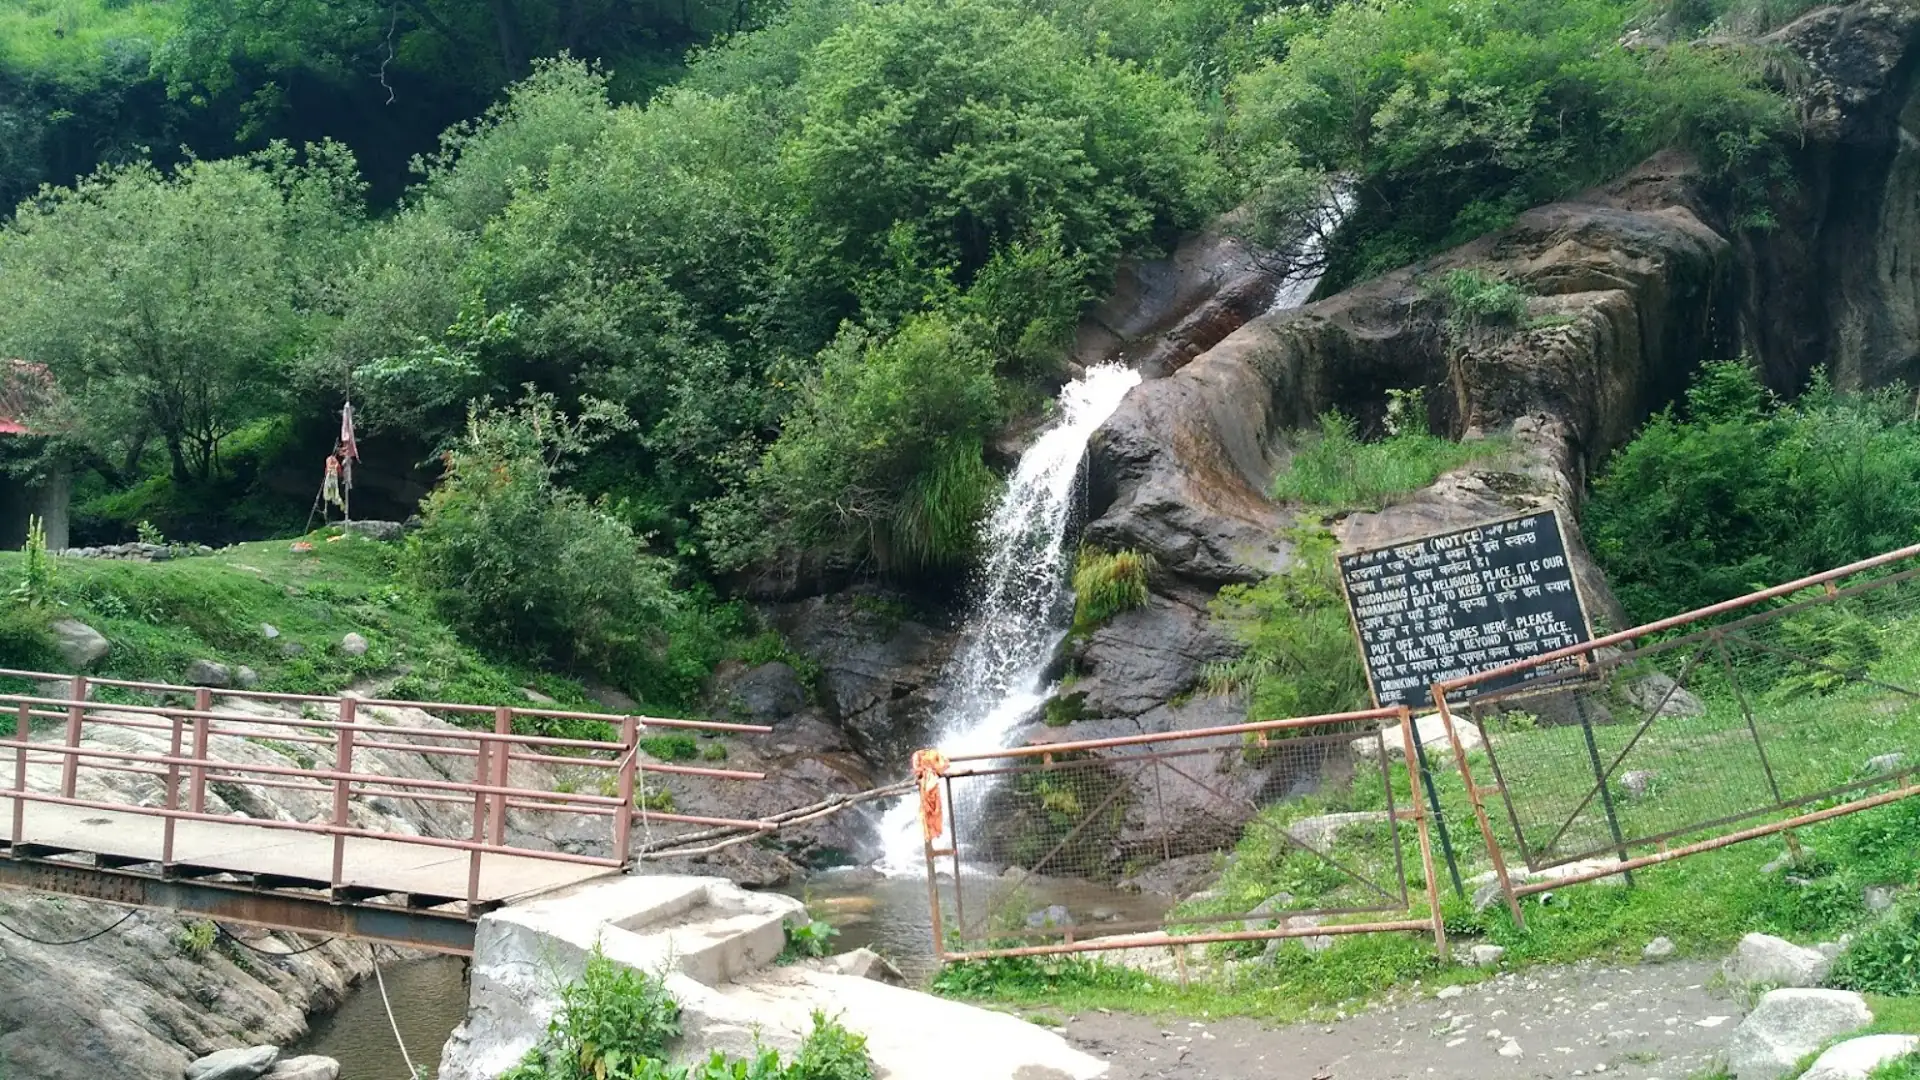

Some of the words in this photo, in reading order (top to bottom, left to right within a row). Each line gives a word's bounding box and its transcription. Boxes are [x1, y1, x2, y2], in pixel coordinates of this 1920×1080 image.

[1387, 560, 1404, 571] एक
[1481, 539, 1499, 552] इसे
[1505, 532, 1535, 546] स्वच्छ
[1394, 543, 1426, 559] सूचना
[1430, 529, 1483, 551] (NOTICE)
[1359, 588, 1407, 605] RUDRANAG
[1410, 585, 1419, 596] IS
[1423, 583, 1429, 594] A
[1433, 573, 1479, 591] RELIGIOUS
[1483, 566, 1513, 581] PLACE.
[1516, 563, 1525, 574] IT
[1530, 560, 1540, 572] IS
[1543, 556, 1563, 569] OUR
[1381, 574, 1406, 586] हमारा
[1413, 569, 1433, 580] परम
[1523, 586, 1540, 597] इस
[1357, 599, 1407, 616] PARAMOUNT
[1413, 593, 1436, 607] DUTY
[1442, 590, 1455, 600] TO
[1458, 584, 1482, 597] KEEP
[1487, 581, 1495, 592] IT
[1501, 574, 1535, 589] CLEAN.
[1363, 630, 1372, 641] से
[1401, 625, 1409, 635] न
[1370, 653, 1394, 666] DON'T
[1401, 647, 1427, 660] TAKE
[1431, 641, 1458, 655] THEM
[1464, 635, 1500, 649] BEYOND
[1507, 628, 1529, 641] THIS
[1536, 621, 1571, 636] PLACE.
[1371, 642, 1390, 655] PUT
[1396, 638, 1413, 651] OFF
[1420, 633, 1445, 646] YOUR
[1450, 626, 1478, 641] SHOES
[1516, 612, 1554, 627] PLEASE
[1395, 664, 1407, 674] पर
[1542, 637, 1560, 648] मना
[1381, 677, 1419, 690] DRINKING
[1423, 675, 1430, 684] &
[1433, 668, 1469, 683] SMOKING
[1472, 665, 1480, 675] IS
[1380, 690, 1405, 702] HERE.
